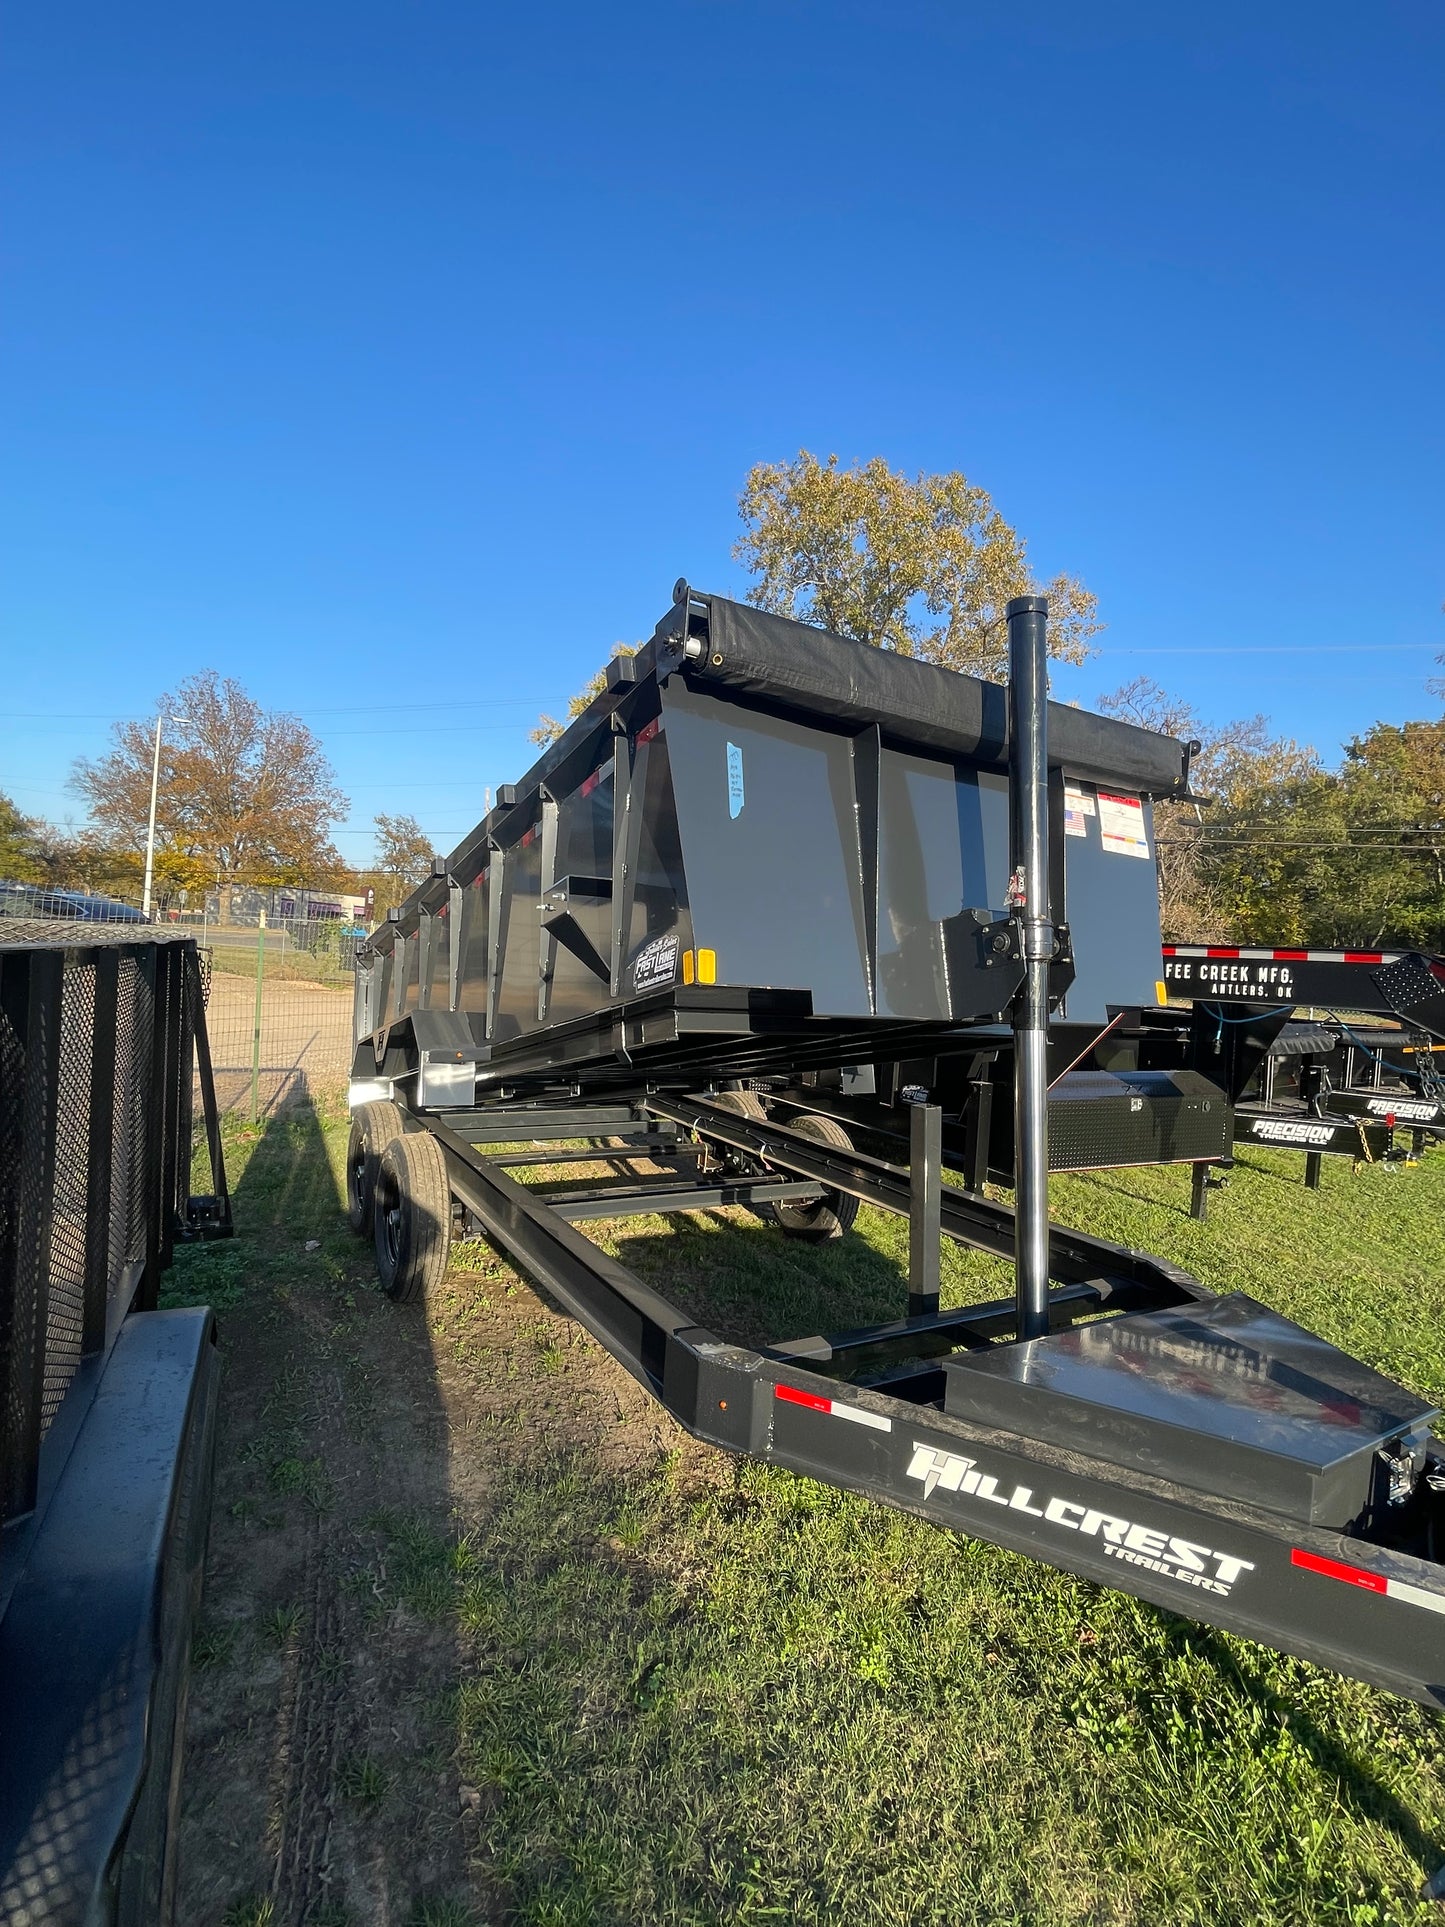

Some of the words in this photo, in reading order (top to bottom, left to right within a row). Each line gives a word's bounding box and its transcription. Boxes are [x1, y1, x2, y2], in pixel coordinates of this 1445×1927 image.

[636, 954, 656, 975] FAST
[653, 948, 676, 973] LANE
[1199, 964, 1249, 982] CREEK
[1258, 967, 1294, 984] MFG.
[1277, 986, 1292, 998] OK
[1366, 1099, 1439, 1117] PRECISION
[1252, 1120, 1335, 1141] PRECISION
[1258, 1132, 1307, 1143] TRAILERS
[906, 1441, 1255, 1584] HILLCREST
[1103, 1542, 1232, 1597] TRAILERS
